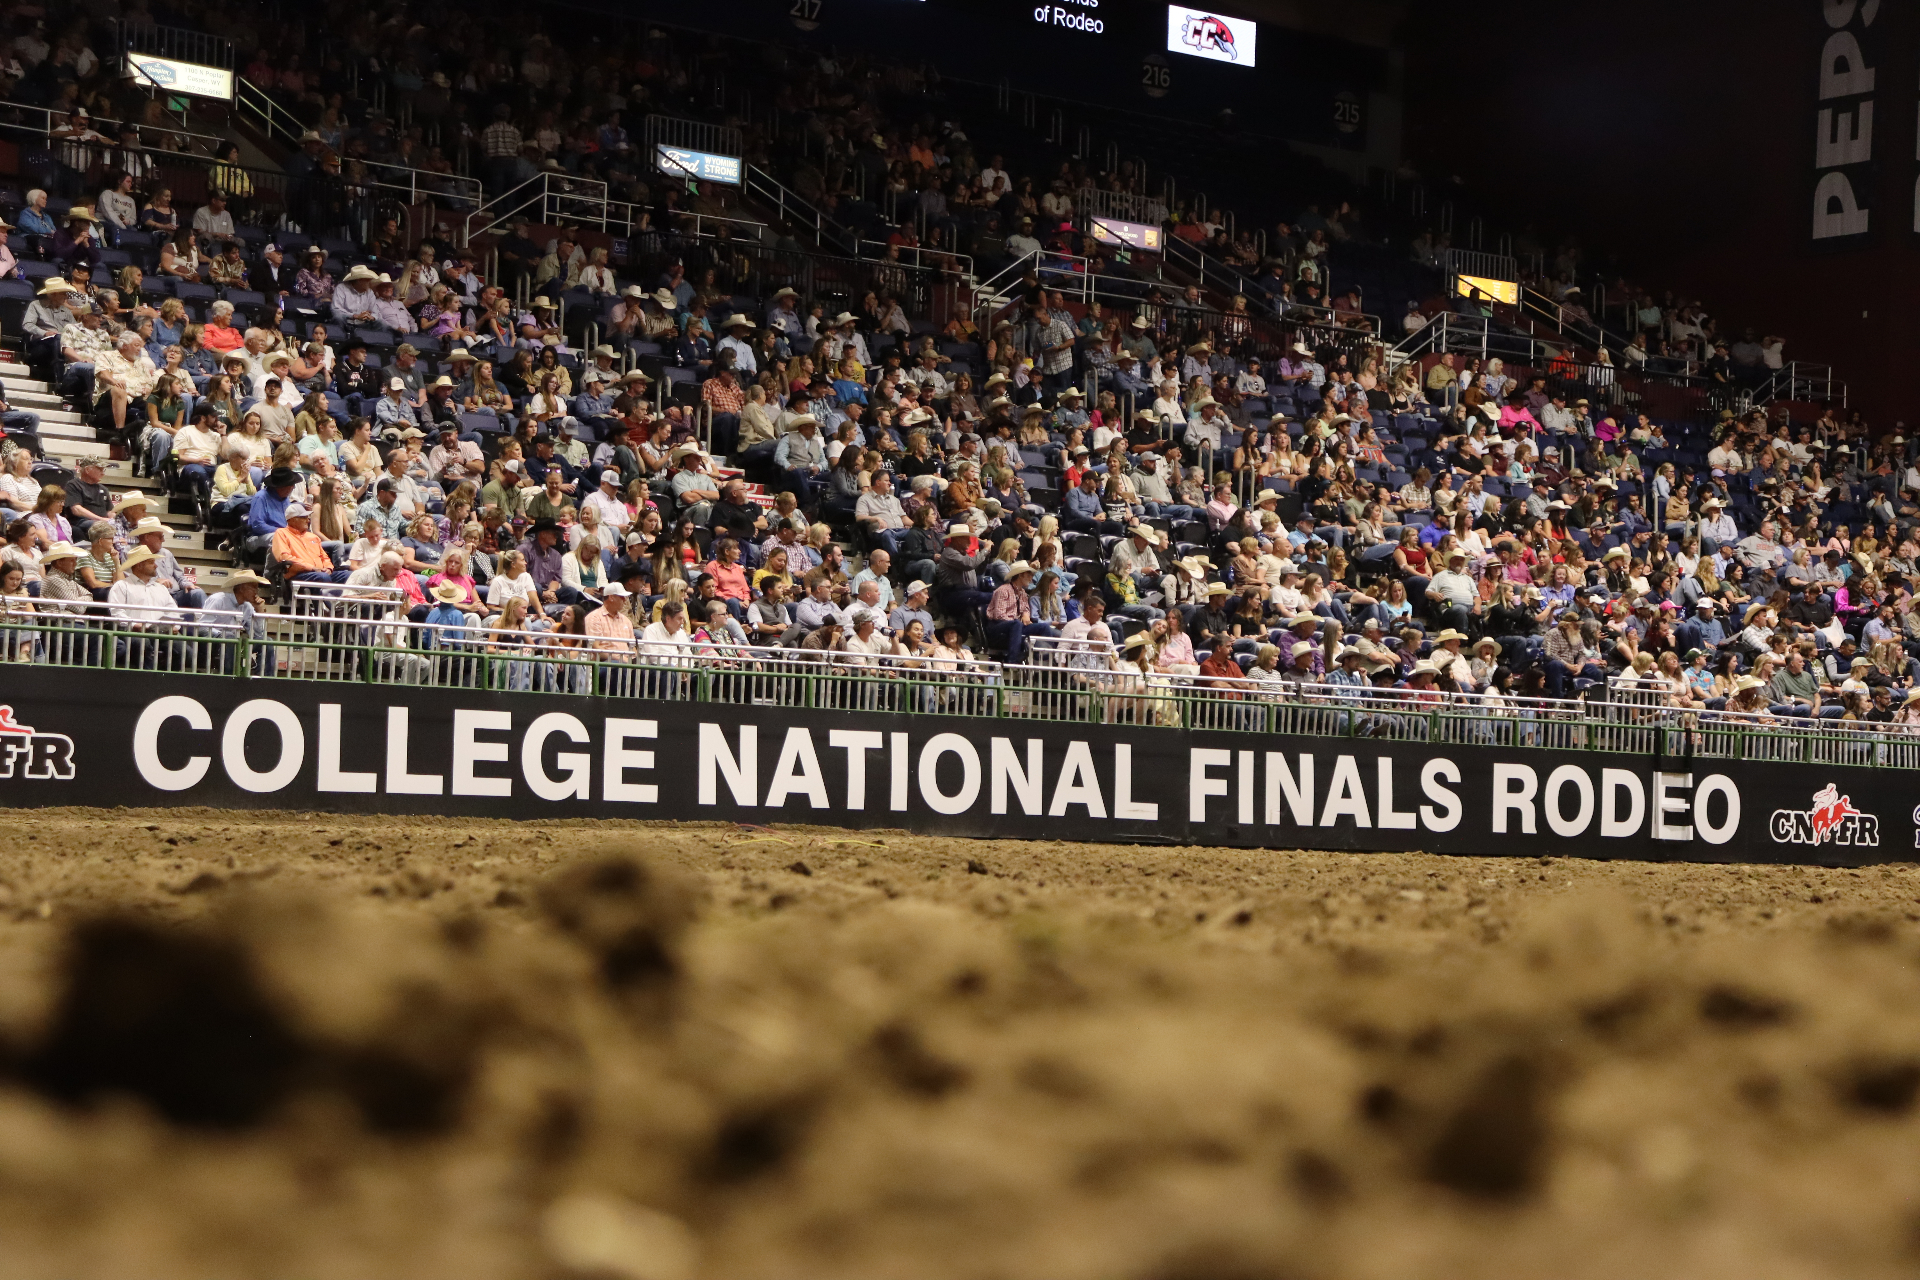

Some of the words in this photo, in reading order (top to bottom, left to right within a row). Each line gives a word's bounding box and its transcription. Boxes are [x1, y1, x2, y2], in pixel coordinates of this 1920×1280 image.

[789, 0, 822, 20] 217
[1034, 5, 1050, 23] of
[1054, 7, 1104, 33] Rodeo
[1186, 19, 1218, 50] CC
[1143, 65, 1170, 87] 216
[1334, 101, 1360, 123] 215
[661, 150, 700, 173] Ford
[704, 156, 738, 169] WYOMING
[704, 164, 738, 177] STRONG
[756, 499, 774, 507] CLEAN
[134, 695, 659, 803] COLLEGE
[699, 722, 1159, 821] NATIONAL
[1190, 747, 1463, 833] FINALS
[1493, 763, 1740, 845] RODEO
